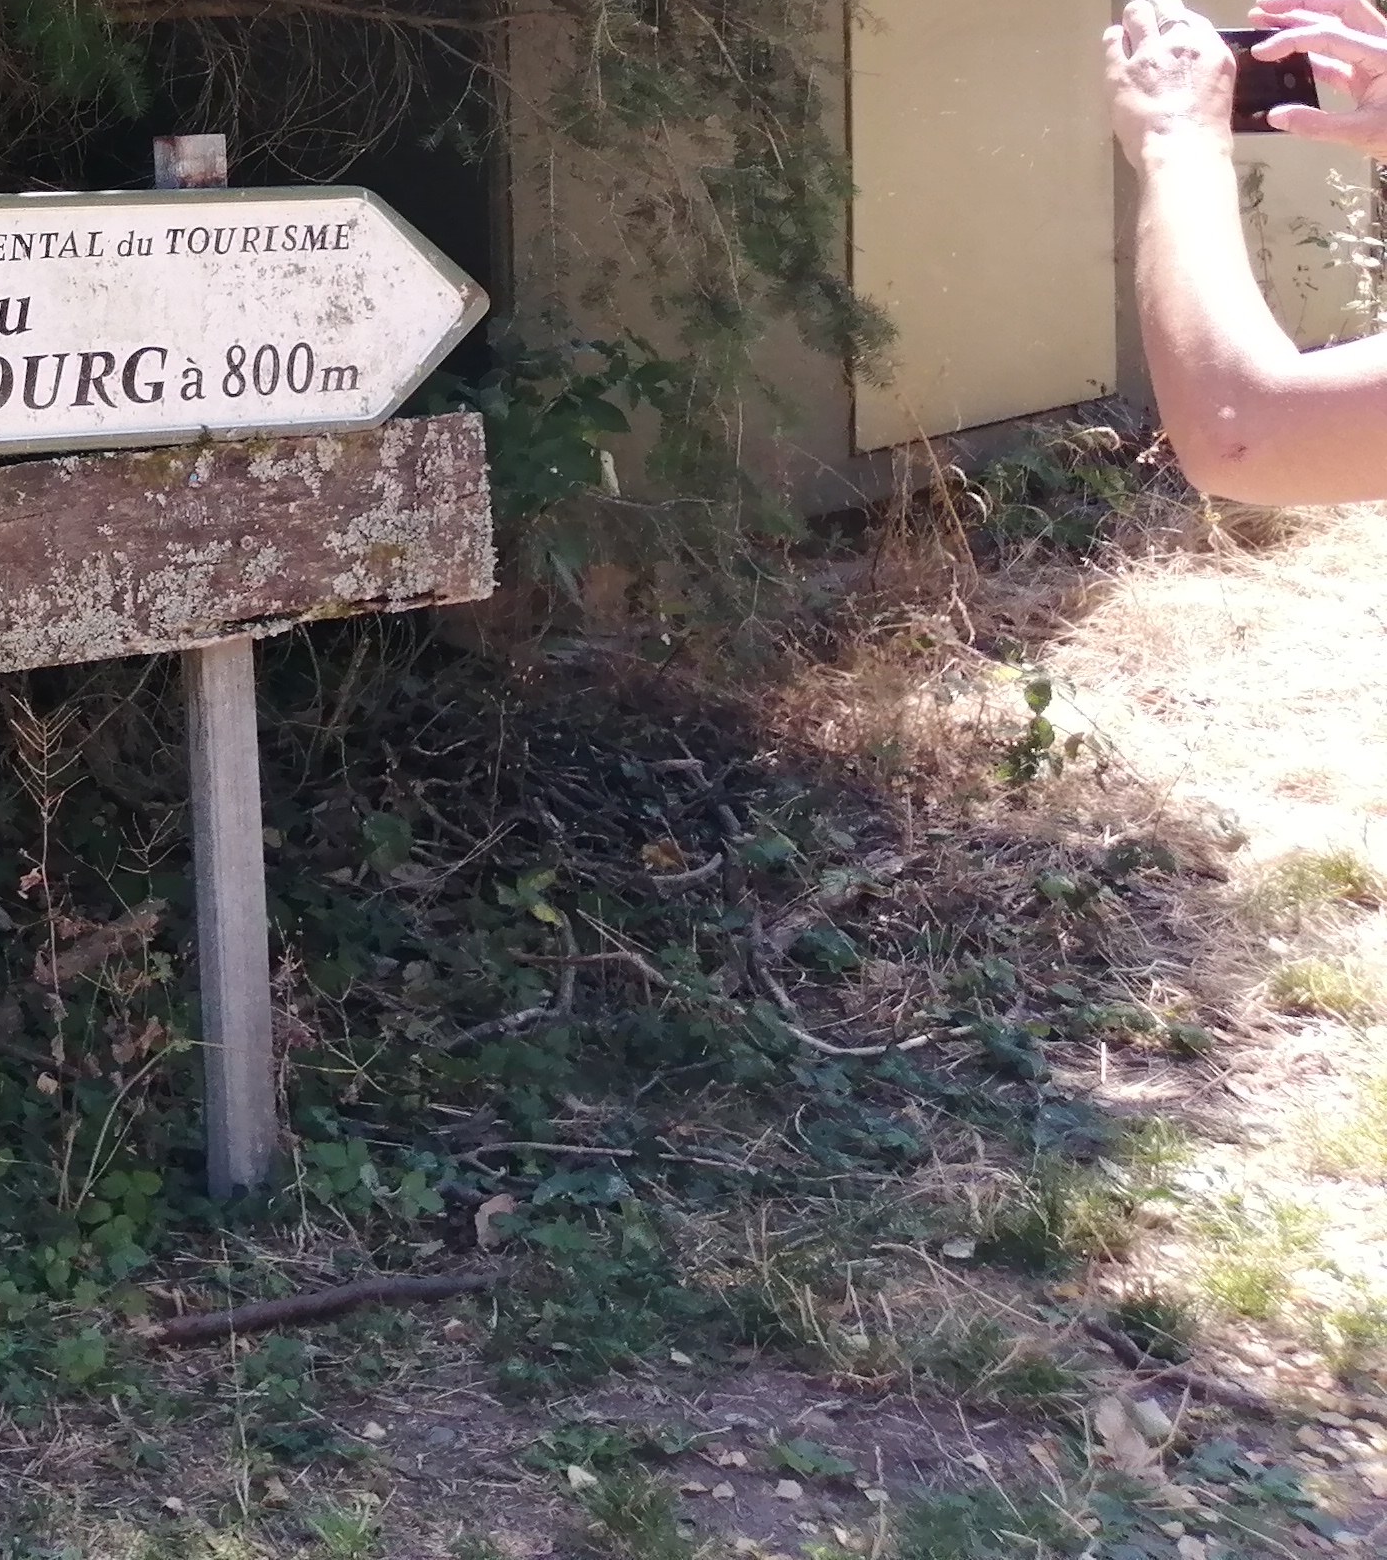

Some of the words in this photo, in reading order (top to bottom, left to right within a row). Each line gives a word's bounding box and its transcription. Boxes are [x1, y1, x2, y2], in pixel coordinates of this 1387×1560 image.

[117, 230, 154, 257] du
[166, 224, 351, 255] TOURISME
[180, 357, 206, 401] à
[221, 342, 360, 398] 800m
